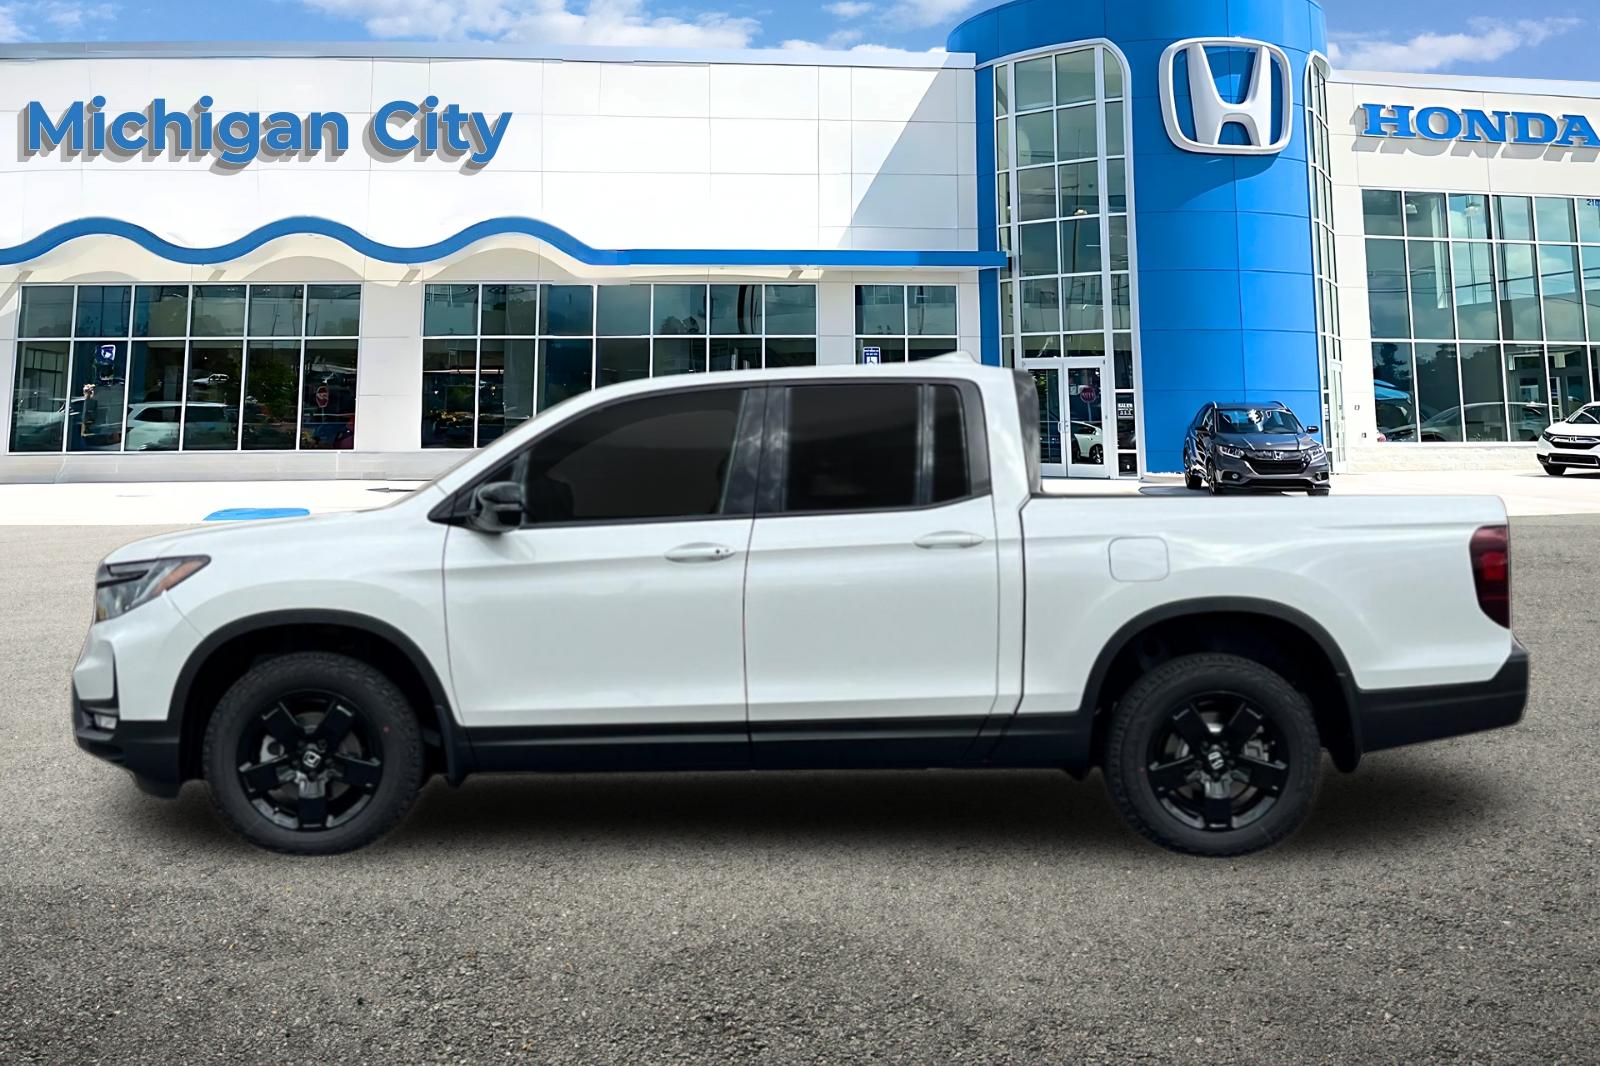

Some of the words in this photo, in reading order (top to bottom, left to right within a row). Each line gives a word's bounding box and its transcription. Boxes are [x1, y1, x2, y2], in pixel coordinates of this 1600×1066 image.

[29, 95, 349, 163] Michigan
[375, 95, 513, 163] City
[1362, 103, 1600, 147] HONDA
